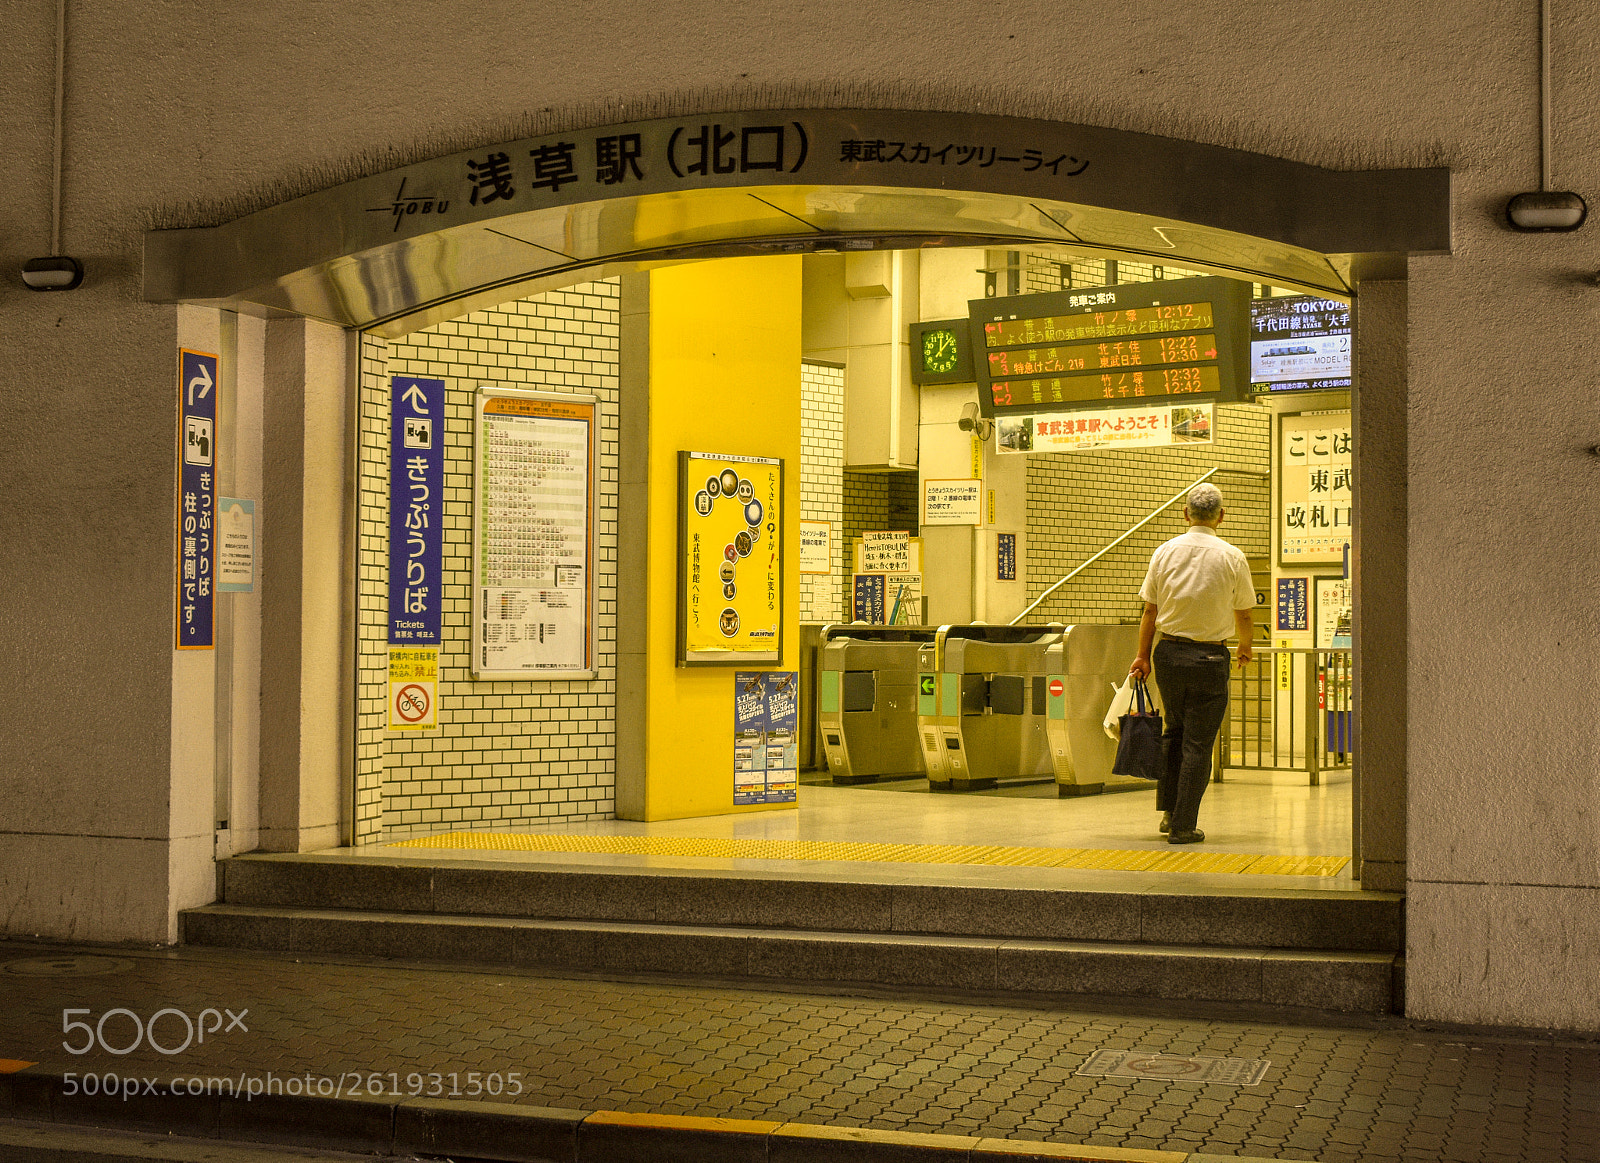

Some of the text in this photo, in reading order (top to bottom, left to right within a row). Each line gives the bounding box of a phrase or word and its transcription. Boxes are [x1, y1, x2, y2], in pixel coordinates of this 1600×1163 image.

[466, 121, 809, 207] 浅草駅（北口）
[840, 139, 1090, 177] 東武スカイツリーライン
[1069, 291, 1116, 308] 発車ご案内
[1294, 299, 1335, 314] TOKYO
[997, 323, 1003, 334] 1
[1094, 309, 1138, 326] 竹ノ塚
[1155, 304, 1194, 319] 12:12
[1255, 316, 1301, 333] 千代田線
[1000, 352, 1007, 364] 2
[1098, 340, 1140, 356] 北千住
[1160, 335, 1197, 351] 12:22
[1001, 364, 1009, 375] 3
[1013, 360, 1064, 375] 特急けごん
[1099, 354, 1142, 368] 東武日光
[1161, 348, 1198, 363] 12:30
[1314, 355, 1341, 365] MODEL
[1004, 382, 1010, 393] 1
[1101, 371, 1144, 387] 竹ノ塚
[1163, 367, 1200, 382] 12:32
[1005, 393, 1013, 405] 2
[1103, 384, 1146, 399] 北千住
[1164, 380, 1202, 394] 12:42
[1036, 414, 1168, 436] 東武浅草駅へようこそ！
[1289, 432, 1351, 457] ここは
[1309, 468, 1351, 493] 東武
[1286, 505, 1351, 529] 改札口
[199, 471, 211, 597] きっぷうりば
[404, 455, 430, 614] きっぷうりば
[184, 492, 197, 635] 柱の裏側です。
[394, 620, 425, 630] Tickets
[414, 666, 438, 677] 禁止
